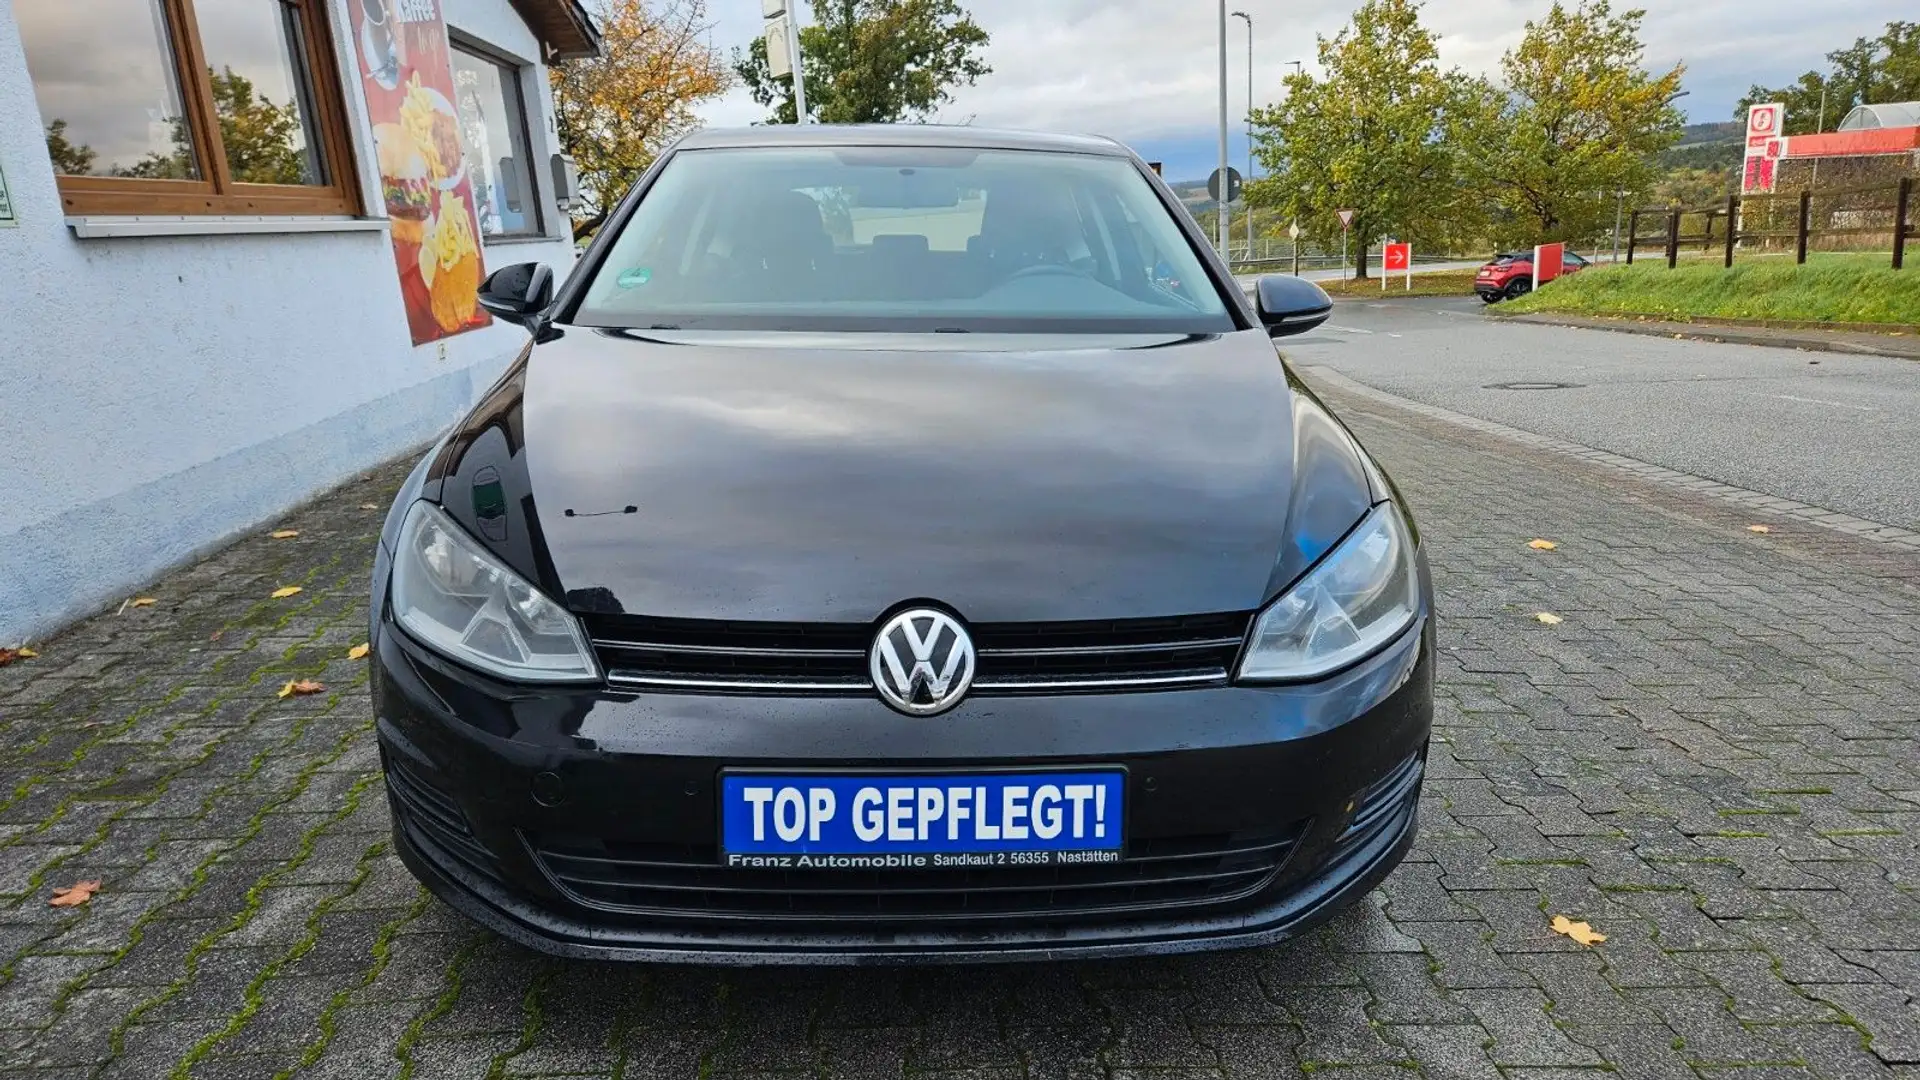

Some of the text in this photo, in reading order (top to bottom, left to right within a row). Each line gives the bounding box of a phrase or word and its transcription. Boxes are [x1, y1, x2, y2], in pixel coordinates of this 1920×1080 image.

[743, 784, 1107, 842] TOP GEPFLEGT!
[728, 850, 1118, 868] Franz Automobile Sandkaut 2 56355 Nastätten
